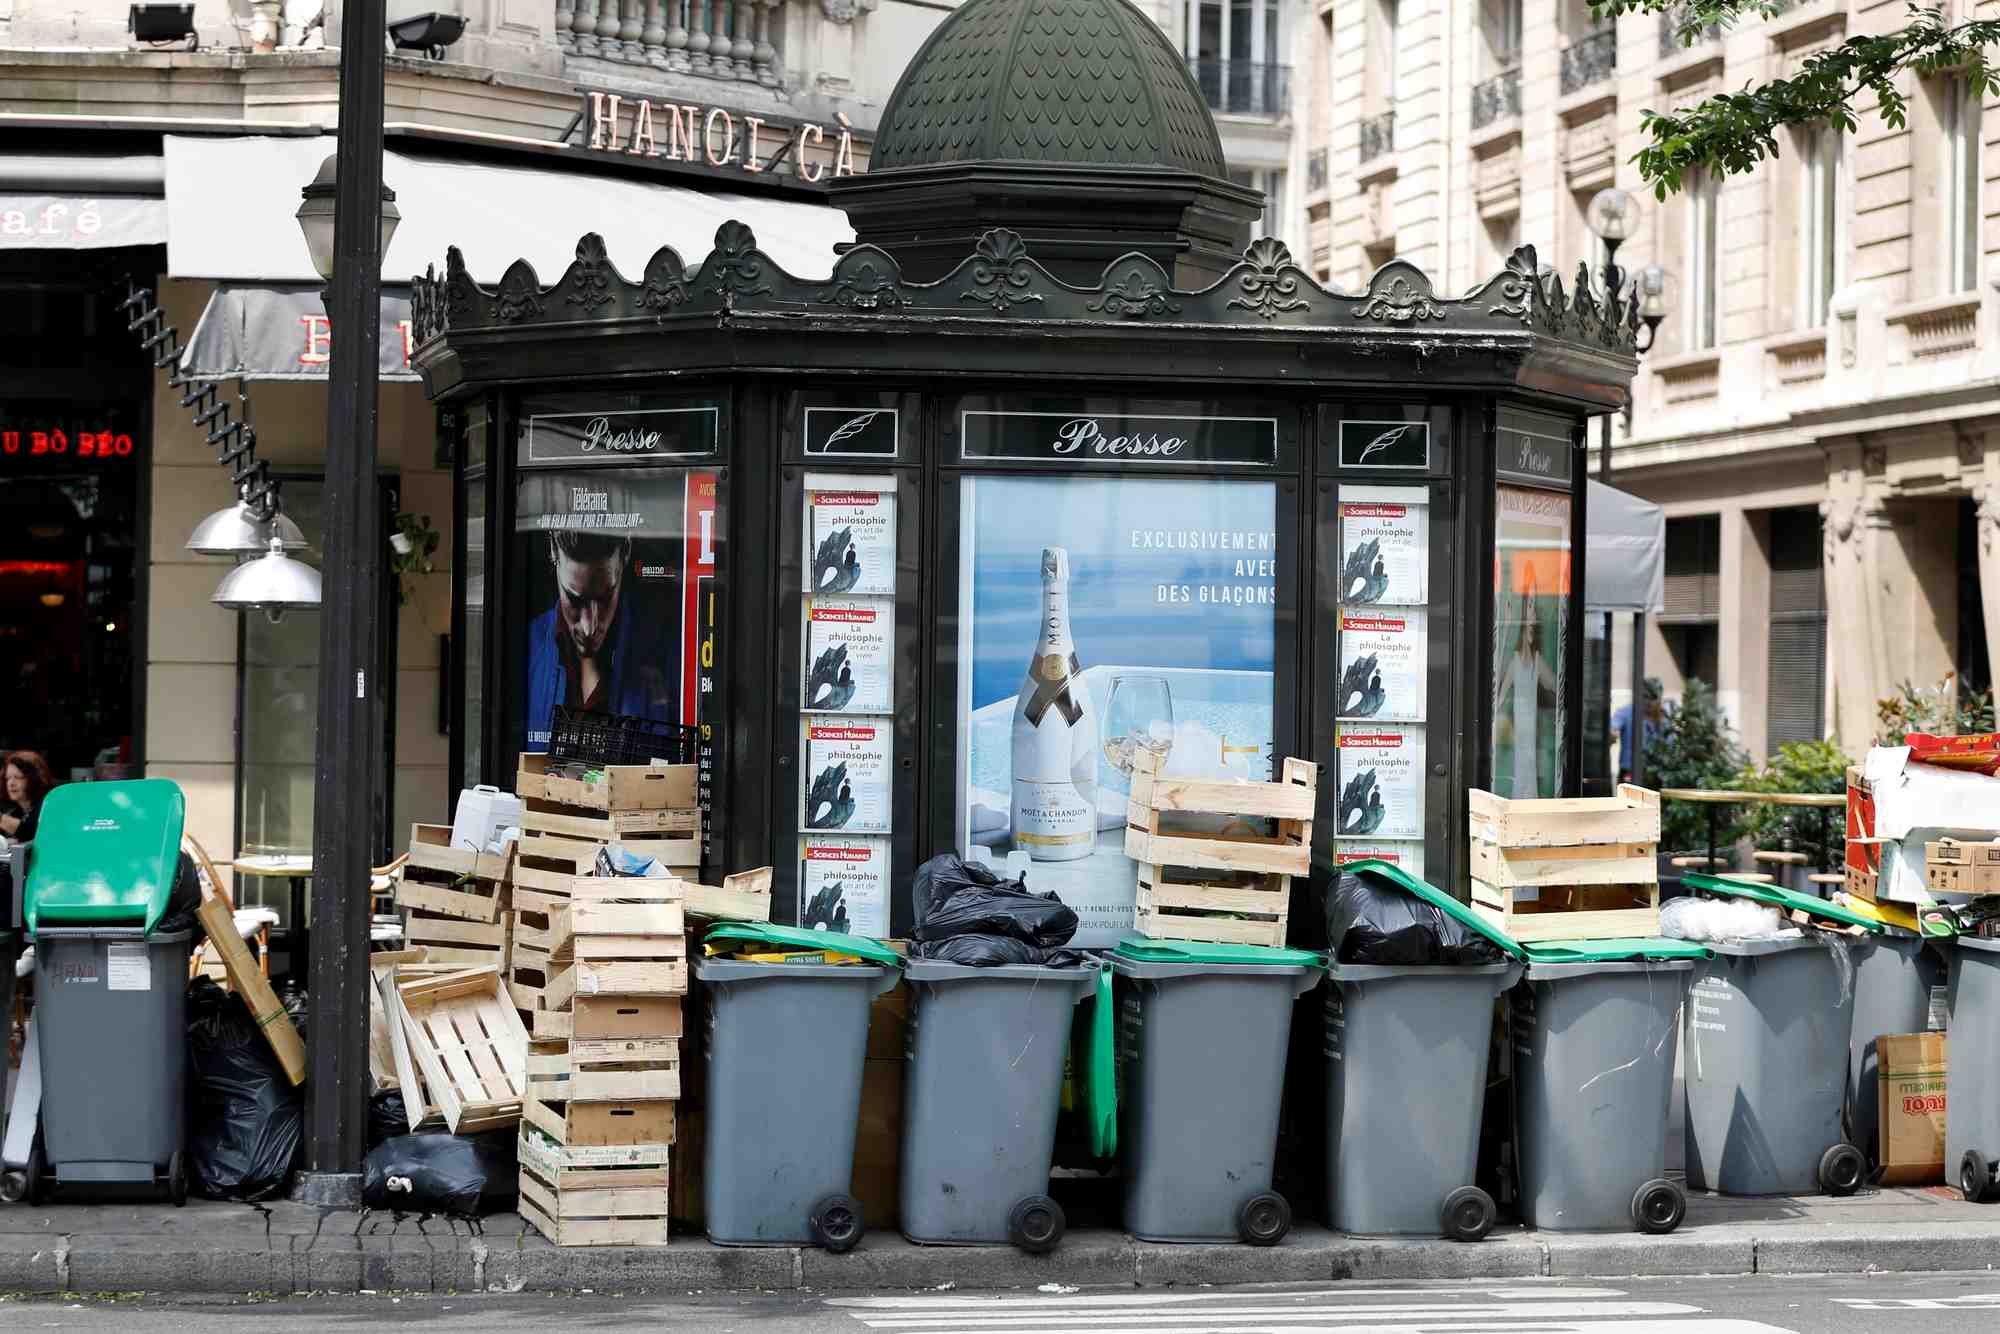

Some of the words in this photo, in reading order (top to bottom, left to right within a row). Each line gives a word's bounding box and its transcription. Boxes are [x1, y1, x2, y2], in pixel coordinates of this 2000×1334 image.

[589, 91, 764, 172] HANOI
[581, 417, 663, 451] Presse
[1053, 418, 1187, 455] Presse
[854, 507, 864, 515] La
[832, 516, 886, 526] philosophie
[1361, 528, 1414, 537] philosophie
[1158, 585, 1191, 602] DES
[828, 633, 883, 643] philosophie
[1360, 641, 1411, 651] philosophie
[828, 751, 882, 760] philosophie
[1358, 759, 1410, 767] philosophie
[823, 871, 879, 880] philosophie
